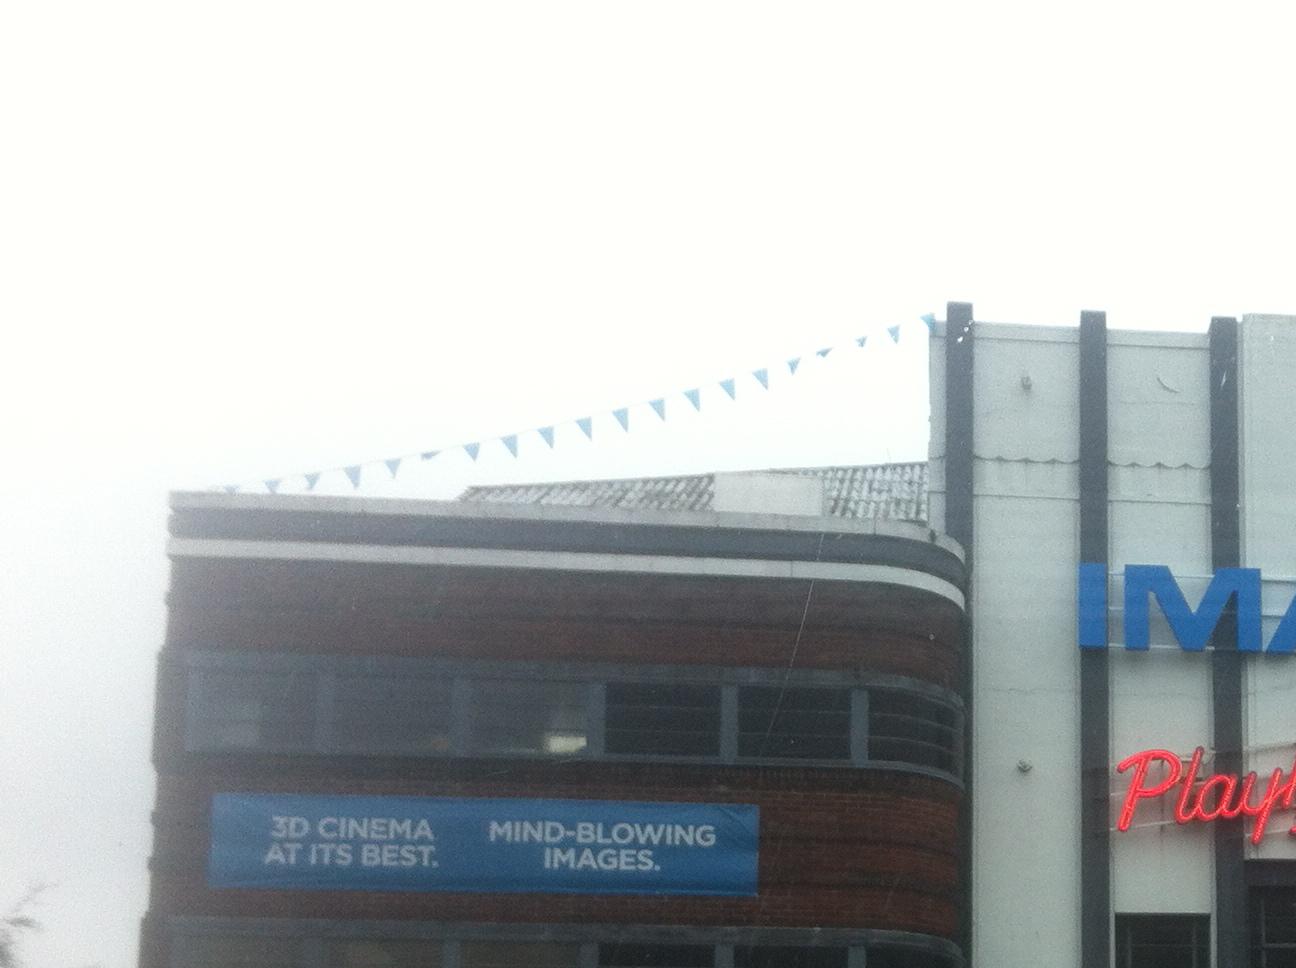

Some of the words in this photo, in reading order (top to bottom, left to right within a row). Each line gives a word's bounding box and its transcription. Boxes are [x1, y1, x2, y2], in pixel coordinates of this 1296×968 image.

[271, 816, 310, 840] 3D
[317, 817, 434, 841] CINEMA
[489, 820, 717, 848] MIND-BLOWING
[265, 844, 304, 865] AT
[311, 845, 350, 866] ITS
[361, 846, 439, 868] BEST.
[544, 848, 661, 872] IMAGES.
